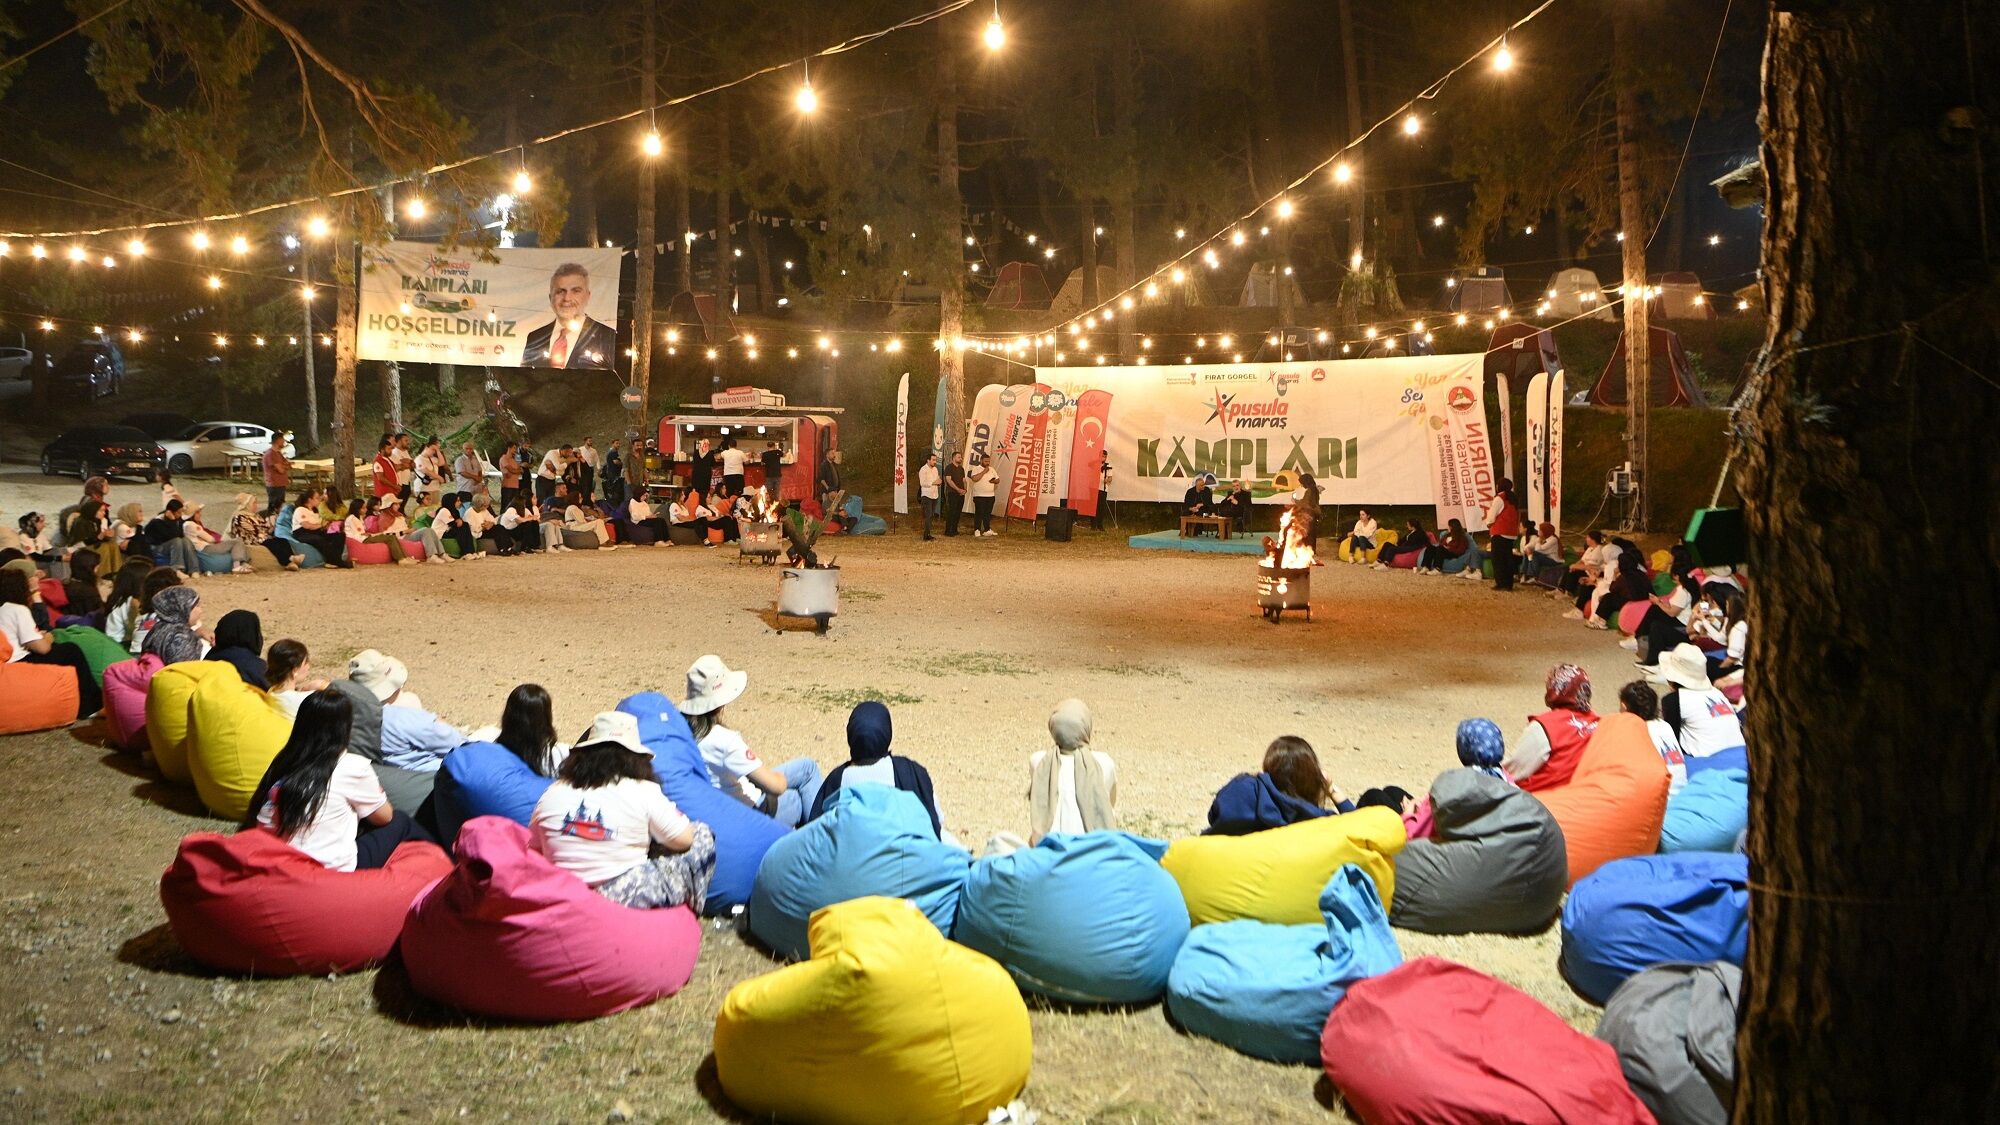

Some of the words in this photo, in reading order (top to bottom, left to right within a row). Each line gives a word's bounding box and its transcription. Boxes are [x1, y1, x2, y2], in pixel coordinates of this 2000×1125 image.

[401, 275, 488, 295] KAMPLARI
[368, 314, 517, 338] HOŞGELDİNİZ
[1228, 397, 1289, 422] pusula
[1235, 415, 1288, 429] maraş
[1003, 413, 1016, 448] pusula
[1012, 423, 1035, 510] ANDIRIN
[1028, 438, 1043, 498] BELEDİYESİ
[1137, 434, 1358, 479] KAMPLARI
